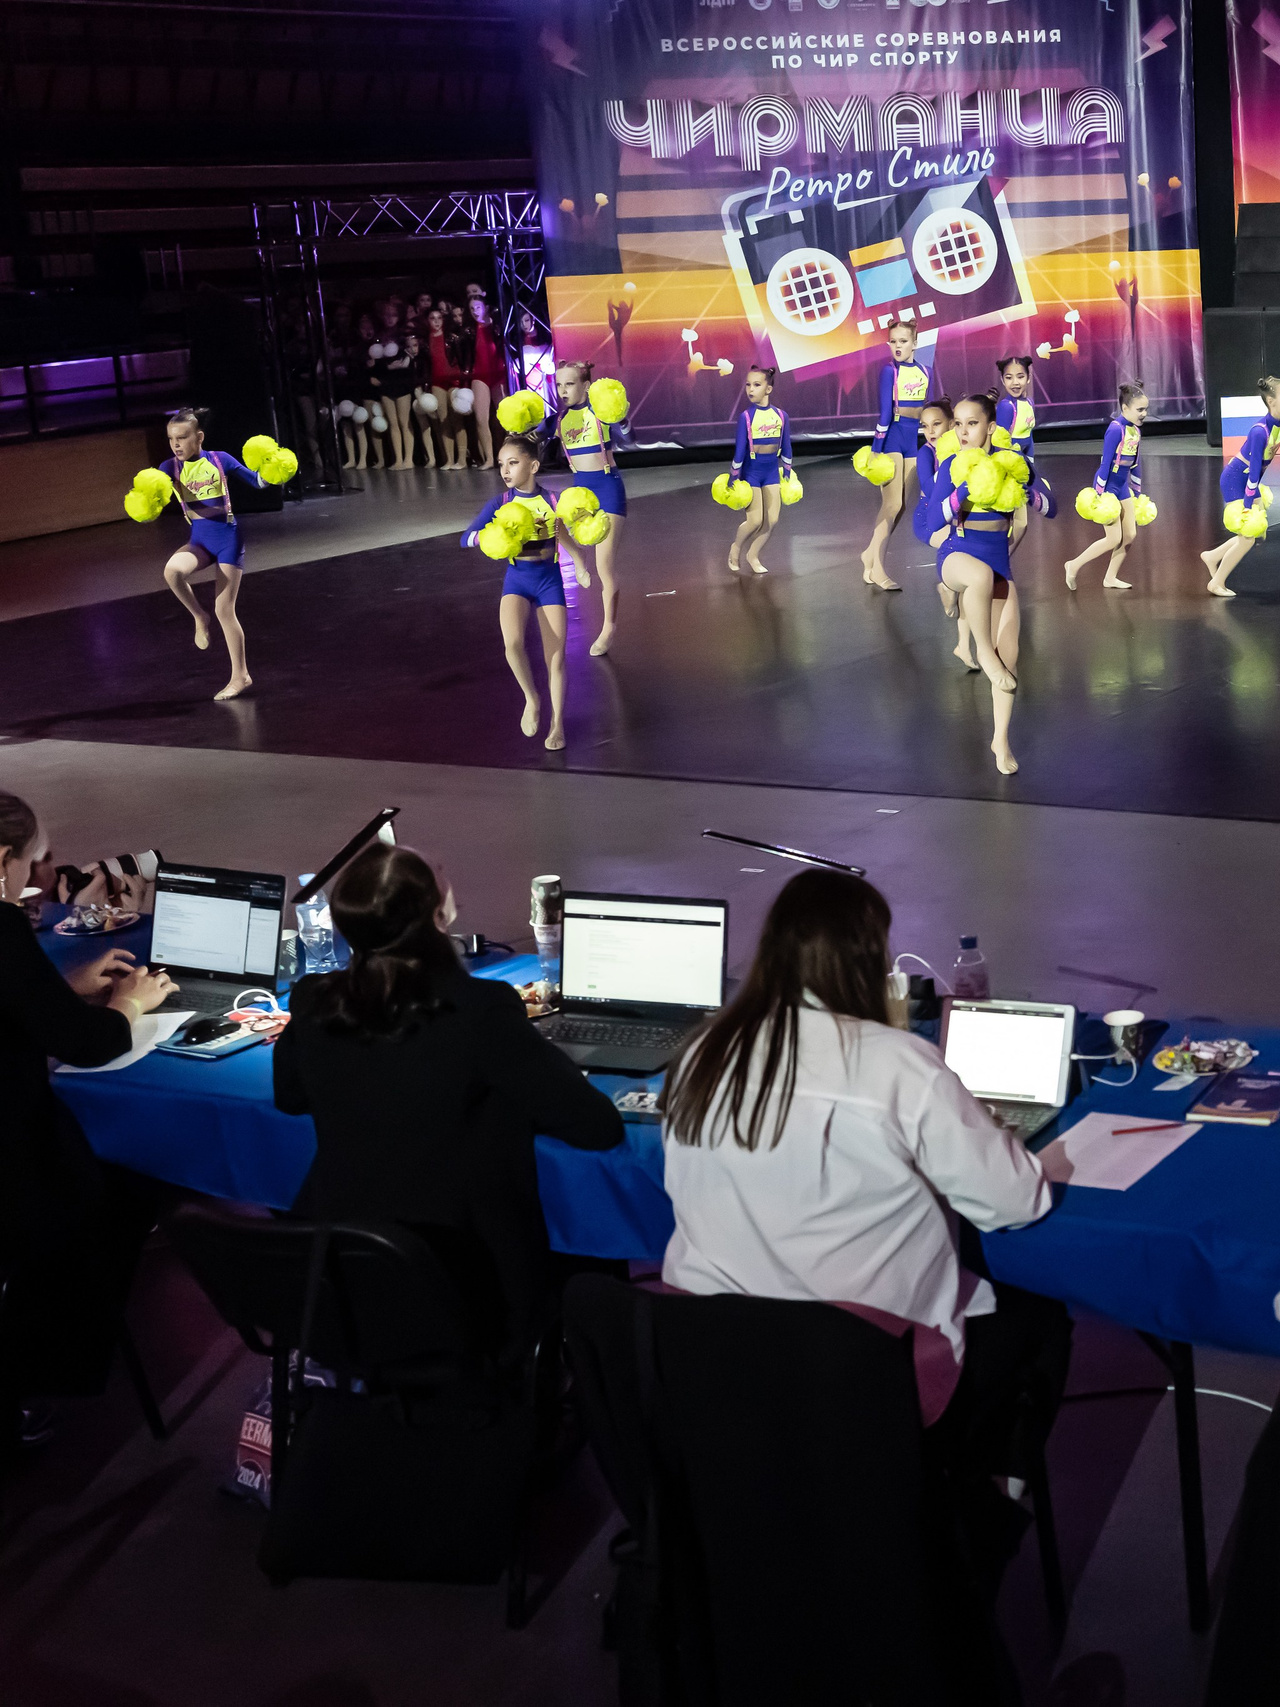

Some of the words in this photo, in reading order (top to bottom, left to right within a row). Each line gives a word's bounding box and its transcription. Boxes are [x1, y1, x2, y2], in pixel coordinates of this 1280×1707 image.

[661, 33, 865, 53] ВСЕРОССИЙСКИЕ
[875, 28, 1063, 48] СОРЕВНОВАНИЯ
[771, 53, 803, 69] ПО
[812, 51, 860, 68] ЧИР
[869, 48, 959, 68] СПОРТУ
[764, 166, 873, 211] Ретро
[888, 145, 996, 188] Стиль
